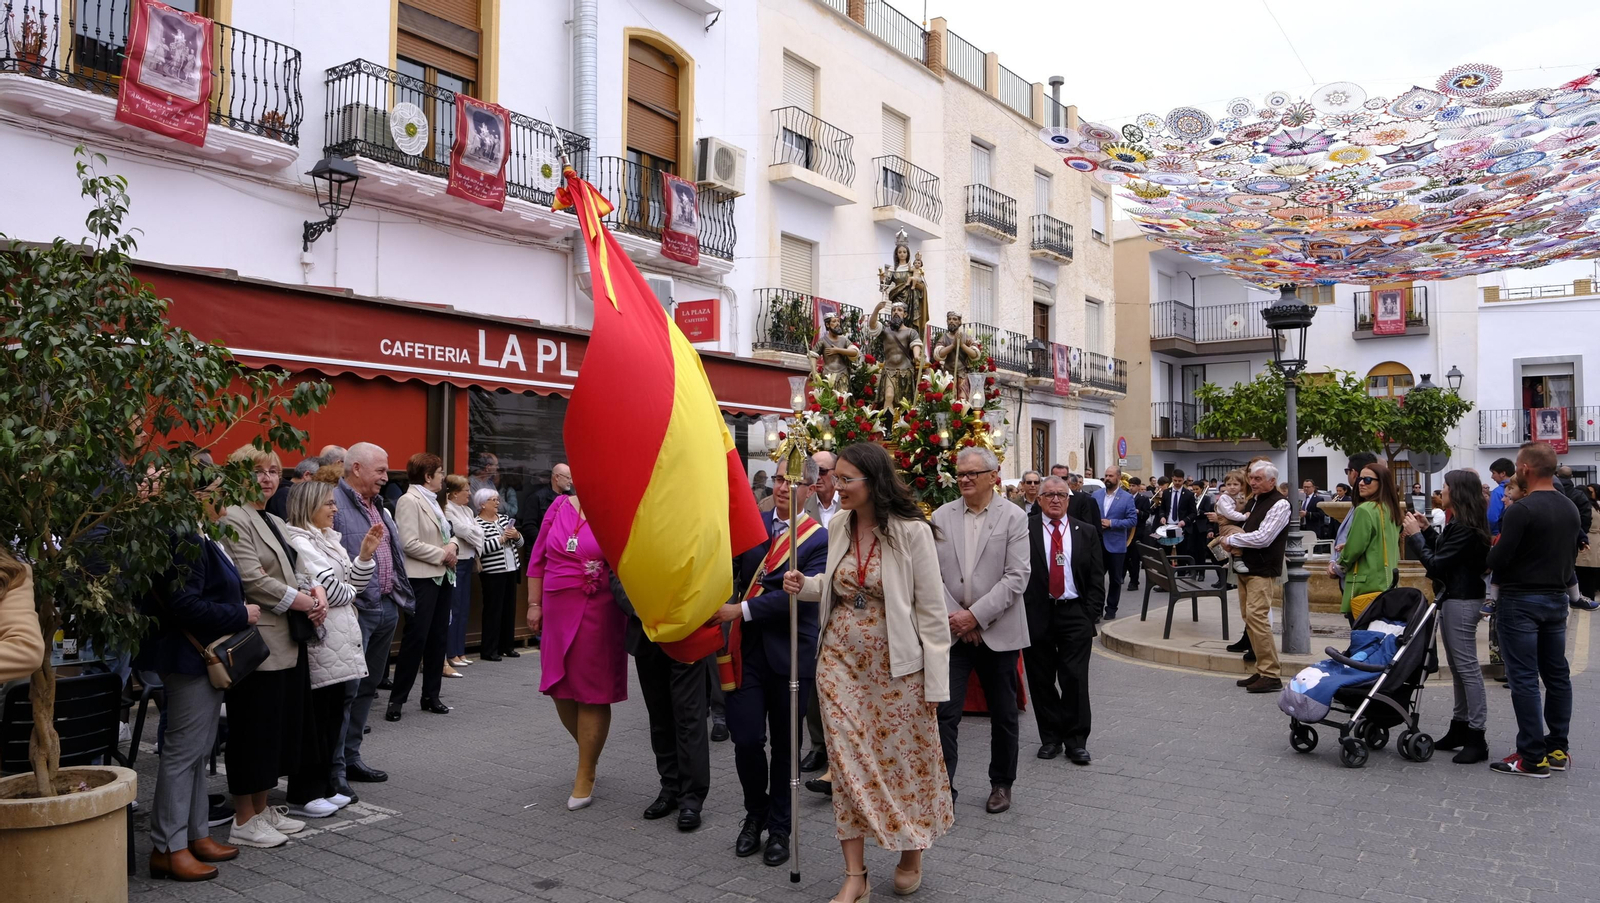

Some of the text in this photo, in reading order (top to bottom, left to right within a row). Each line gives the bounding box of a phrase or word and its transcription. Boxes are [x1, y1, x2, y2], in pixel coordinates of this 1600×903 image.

[380, 329, 579, 377] CAFETERIA LA PL
